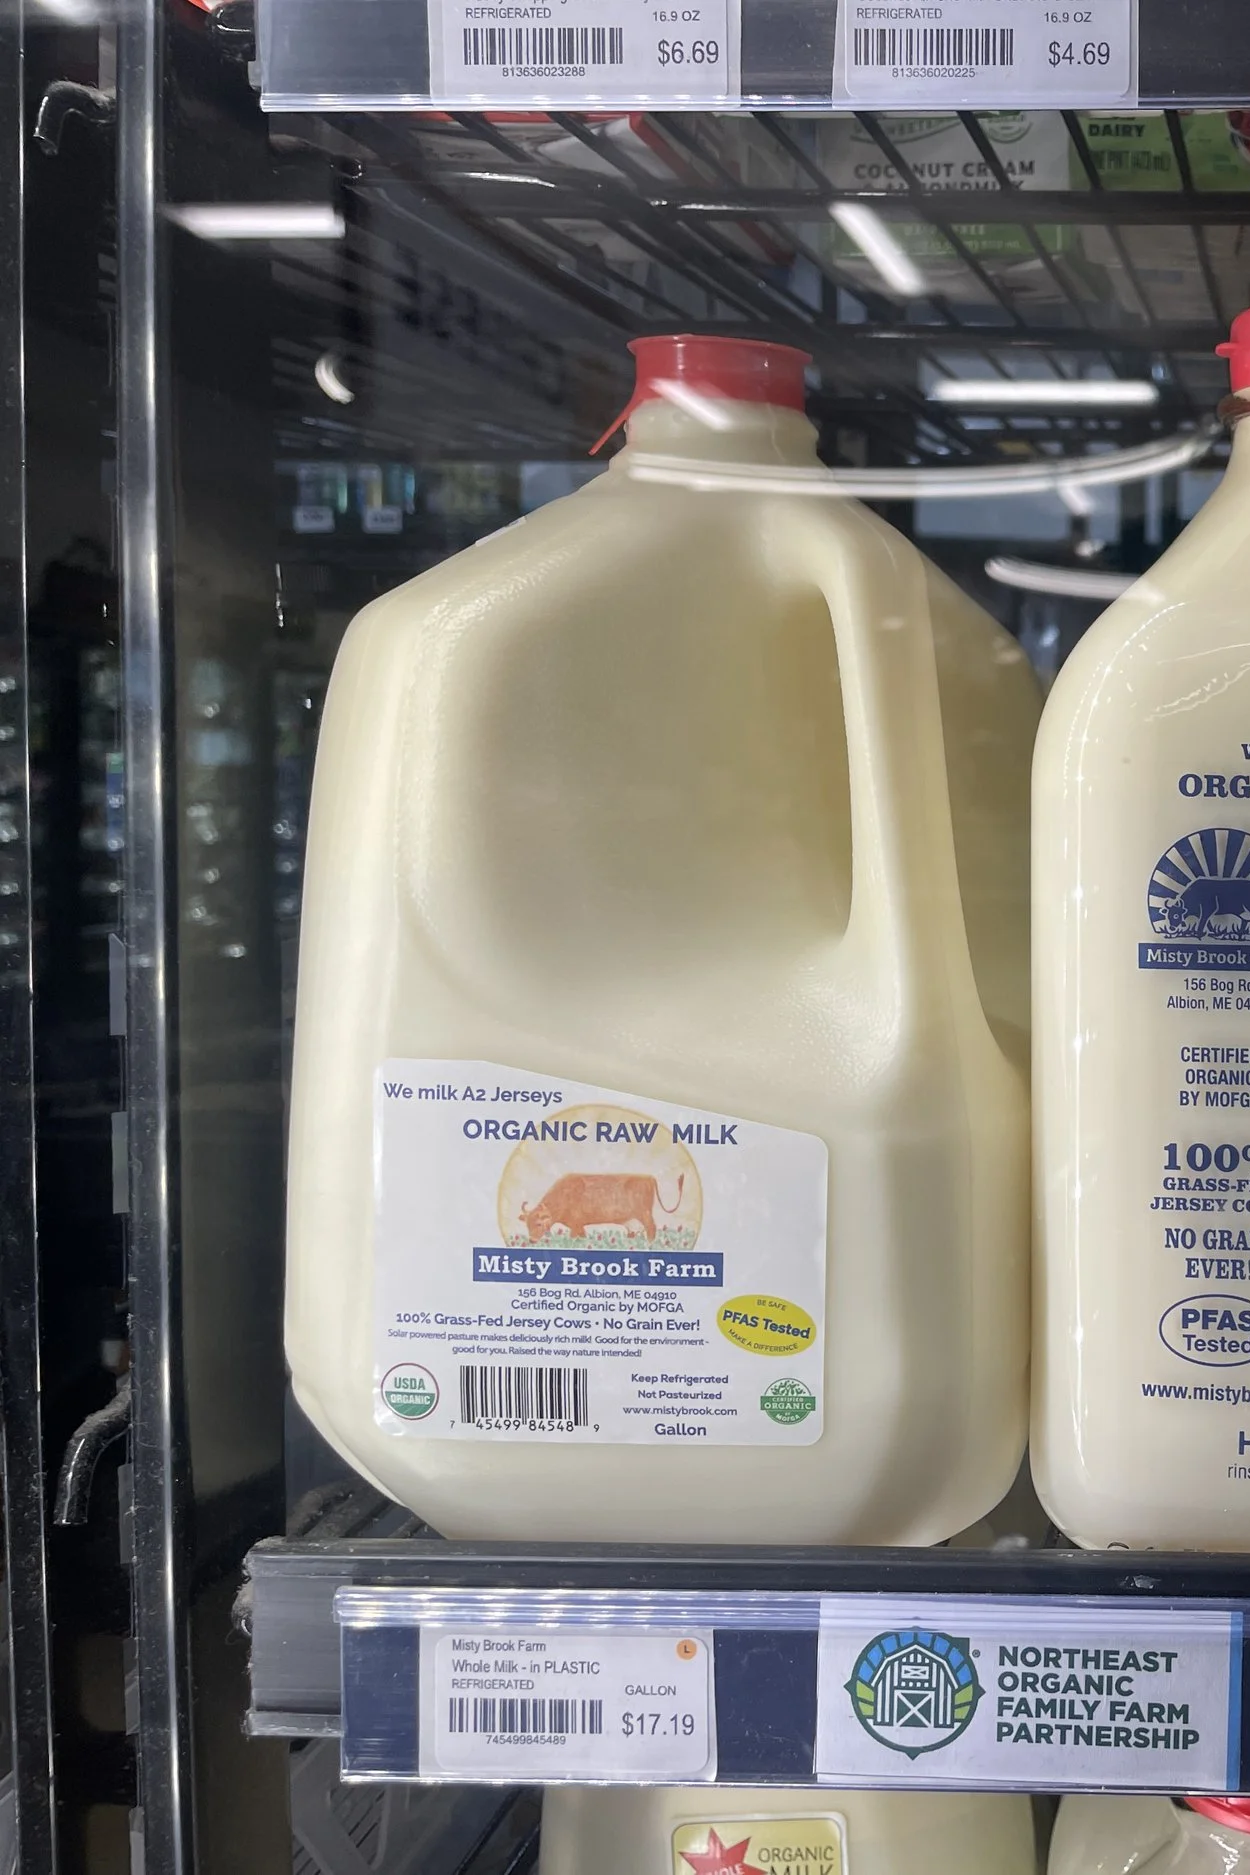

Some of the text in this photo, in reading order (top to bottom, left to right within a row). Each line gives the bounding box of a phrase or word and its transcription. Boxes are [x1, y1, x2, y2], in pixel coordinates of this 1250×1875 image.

[465, 8, 551, 19] REFRIGERATED
[653, 11, 700, 22] 16.9 OZ
[857, 8, 942, 19] REFRIGERATED
[1044, 12, 1091, 23] 16.9 OZ
[658, 39, 719, 66] $6.69
[1048, 41, 1110, 67] $4.69
[502, 67, 585, 76] 813636023288
[892, 67, 975, 77] 813636020225
[1088, 124, 1145, 138] DAIRY
[1146, 949, 1193, 967] Misty
[1197, 949, 1247, 966] Brook
[1183, 978, 1207, 991] 156
[1211, 978, 1236, 995] Bog
[1166, 996, 1209, 1012] Albion,
[1212, 996, 1233, 1010] ME
[383, 1083, 562, 1107] We milk A2 Jerseys
[1179, 1091, 1200, 1106] BY
[463, 1119, 738, 1145] ORGANIC RAW MILK
[1150, 1197, 1228, 1212] JERSEY
[1164, 1228, 1196, 1249] NO
[478, 1255, 716, 1279] Misty Brook Farm
[511, 1298, 684, 1317] Certified Organic by MOFGA
[396, 1312, 700, 1330] 100% Grass-Fed Jersey Cows No Grain Ever!
[722, 1309, 811, 1339] PFAS Tested
[394, 1377, 426, 1390] USDA
[631, 1373, 729, 1387] Keep Refrigerated
[390, 1394, 431, 1405] ORGANIC
[637, 1390, 722, 1401] Not Pasteurized
[622, 1405, 738, 1418] www.mistybrook.com
[654, 1422, 706, 1437] Gallon
[452, 1639, 546, 1653] Misty Brook Farm
[452, 1659, 490, 1673] Whole
[494, 1660, 518, 1673] Milk
[530, 1661, 540, 1673] in
[545, 1661, 600, 1674] PLASTIC
[998, 1646, 1178, 1673] NORTHEAST
[452, 1680, 534, 1690] REFRIGERATED
[625, 1685, 676, 1696] GALLON
[998, 1672, 1134, 1697] ORGANIC
[997, 1697, 1190, 1724] FAMILY FARM
[622, 1712, 695, 1737] $17.19
[486, 1735, 566, 1745] 745499845489
[996, 1723, 1199, 1750] PARTNERSHIP
